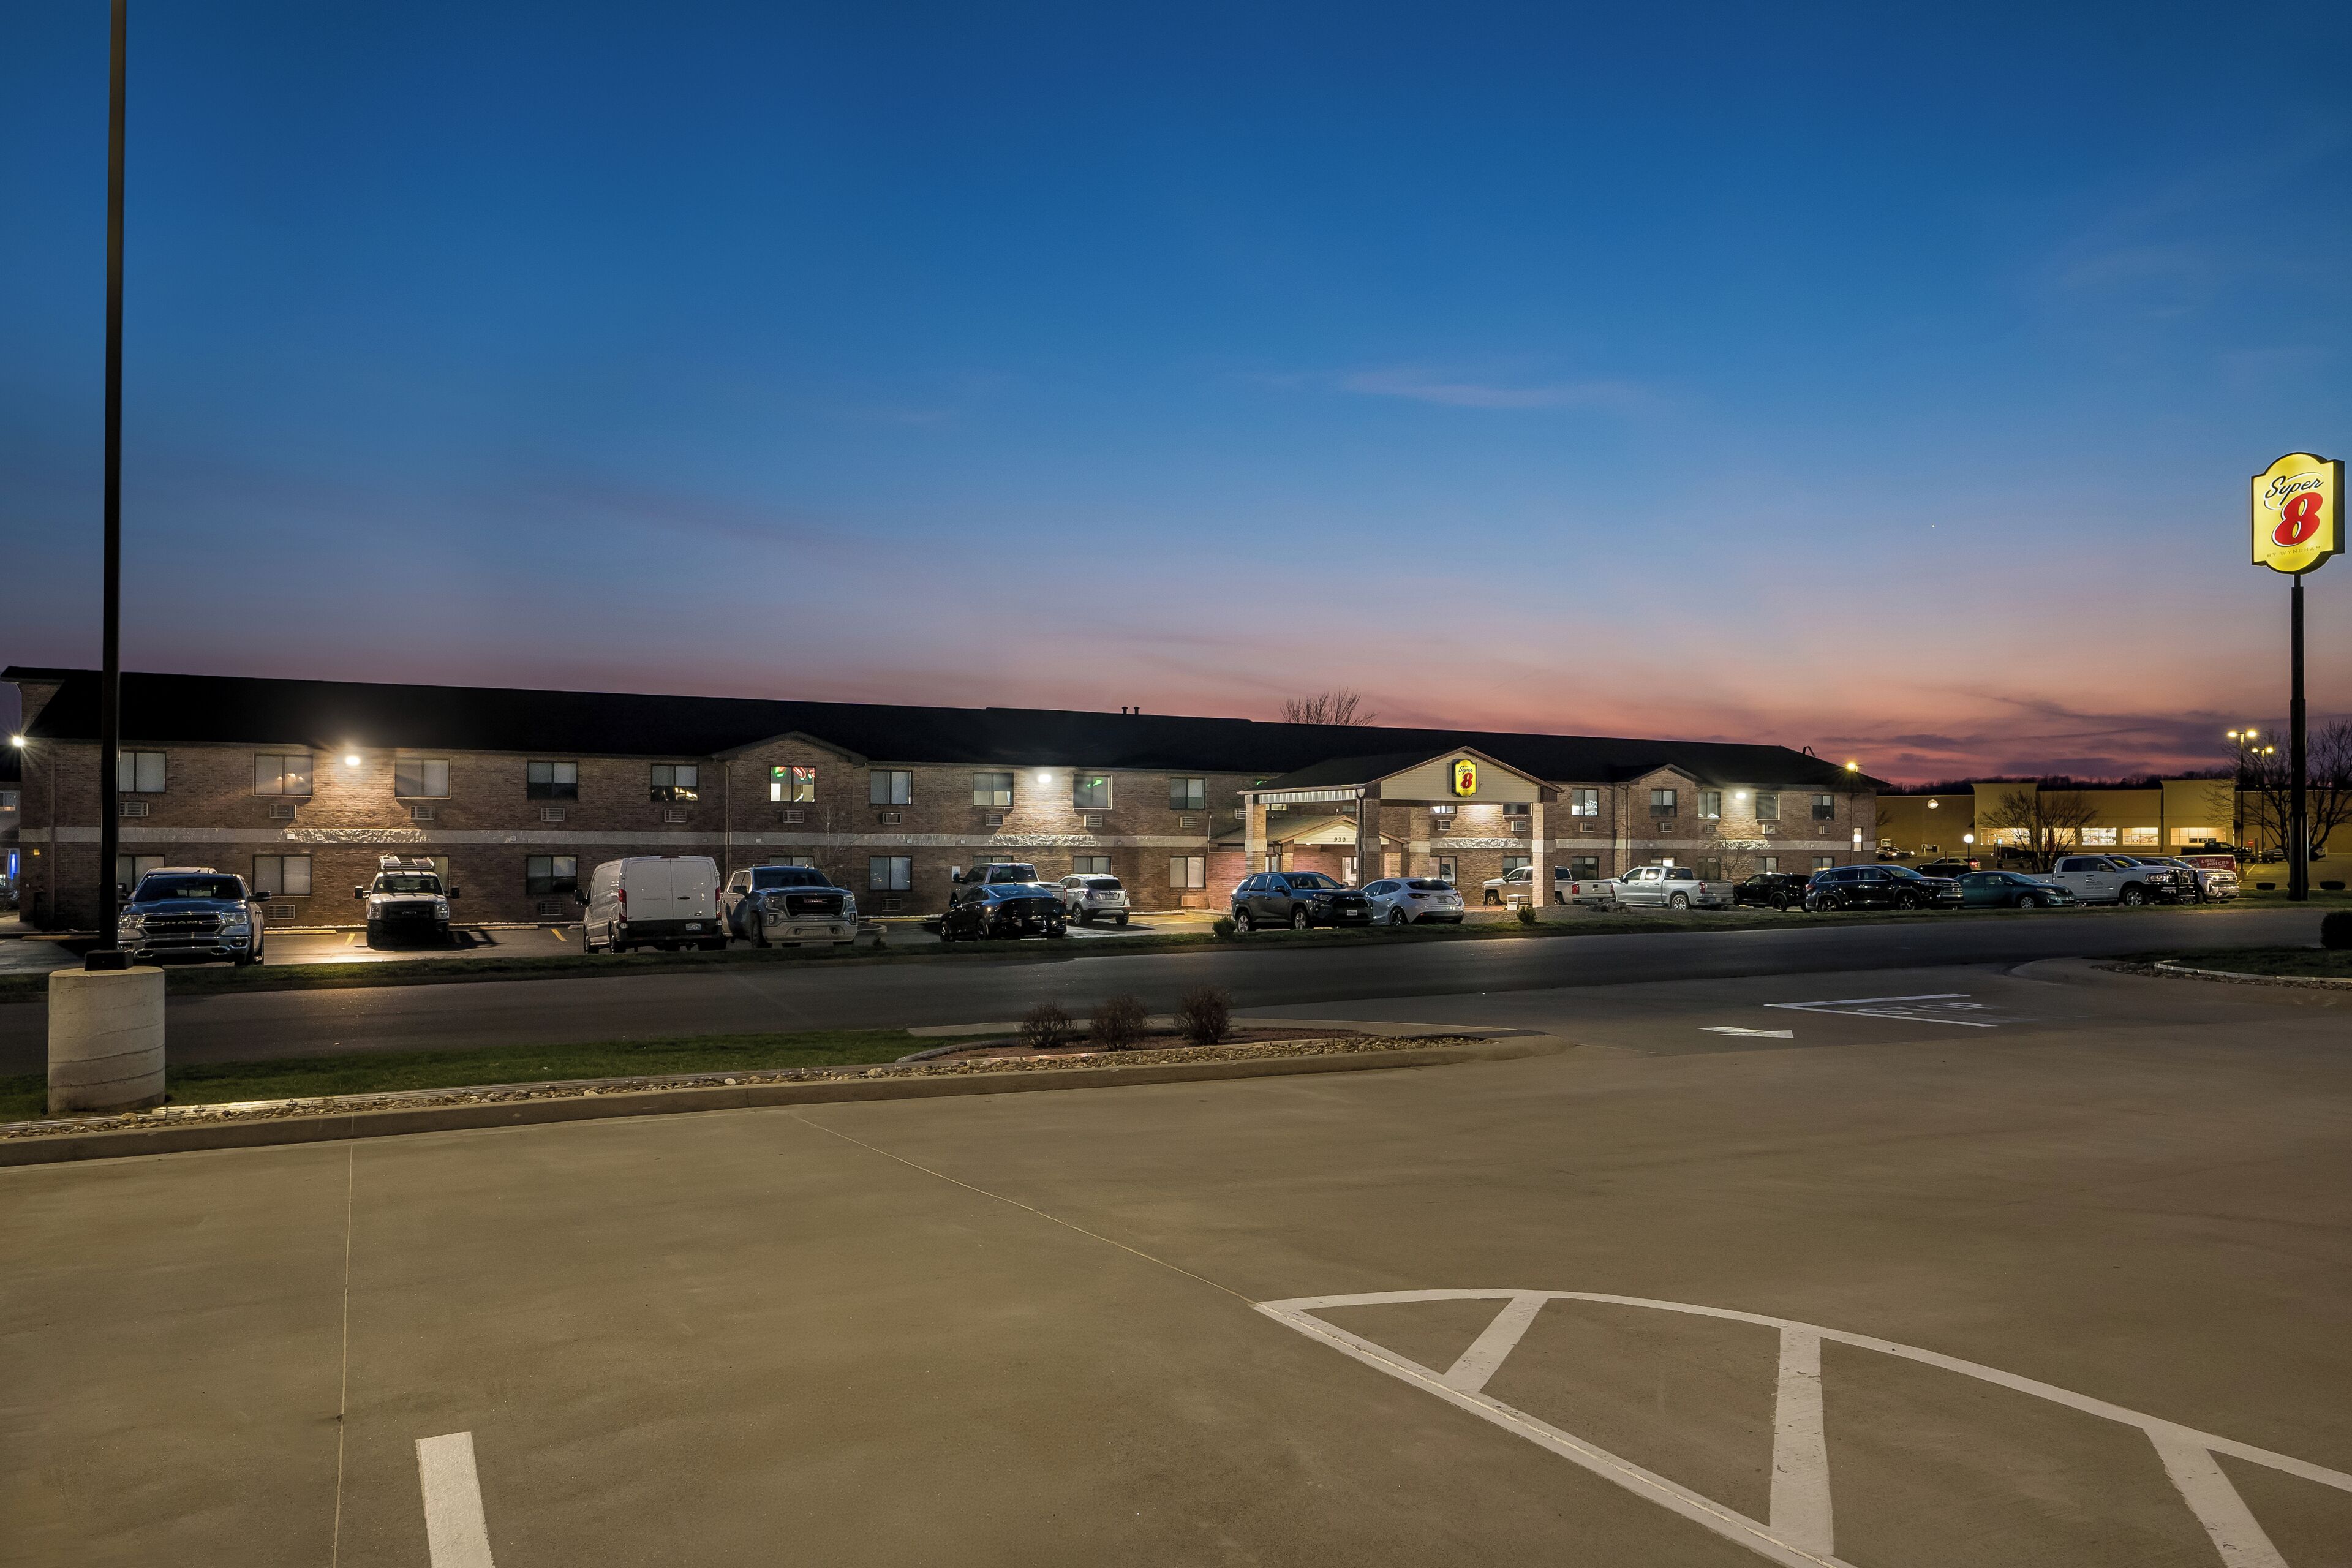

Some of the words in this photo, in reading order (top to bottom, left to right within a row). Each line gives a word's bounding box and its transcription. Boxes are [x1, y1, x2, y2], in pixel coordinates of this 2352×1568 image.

[2264, 475, 2323, 507] Super
[2272, 492, 2323, 546] 8
[2280, 546, 2321, 556] WYNDHAM
[1458, 766, 1473, 775] Super
[1460, 772, 1473, 789] 8
[1857, 1003, 1993, 1014] STOP
